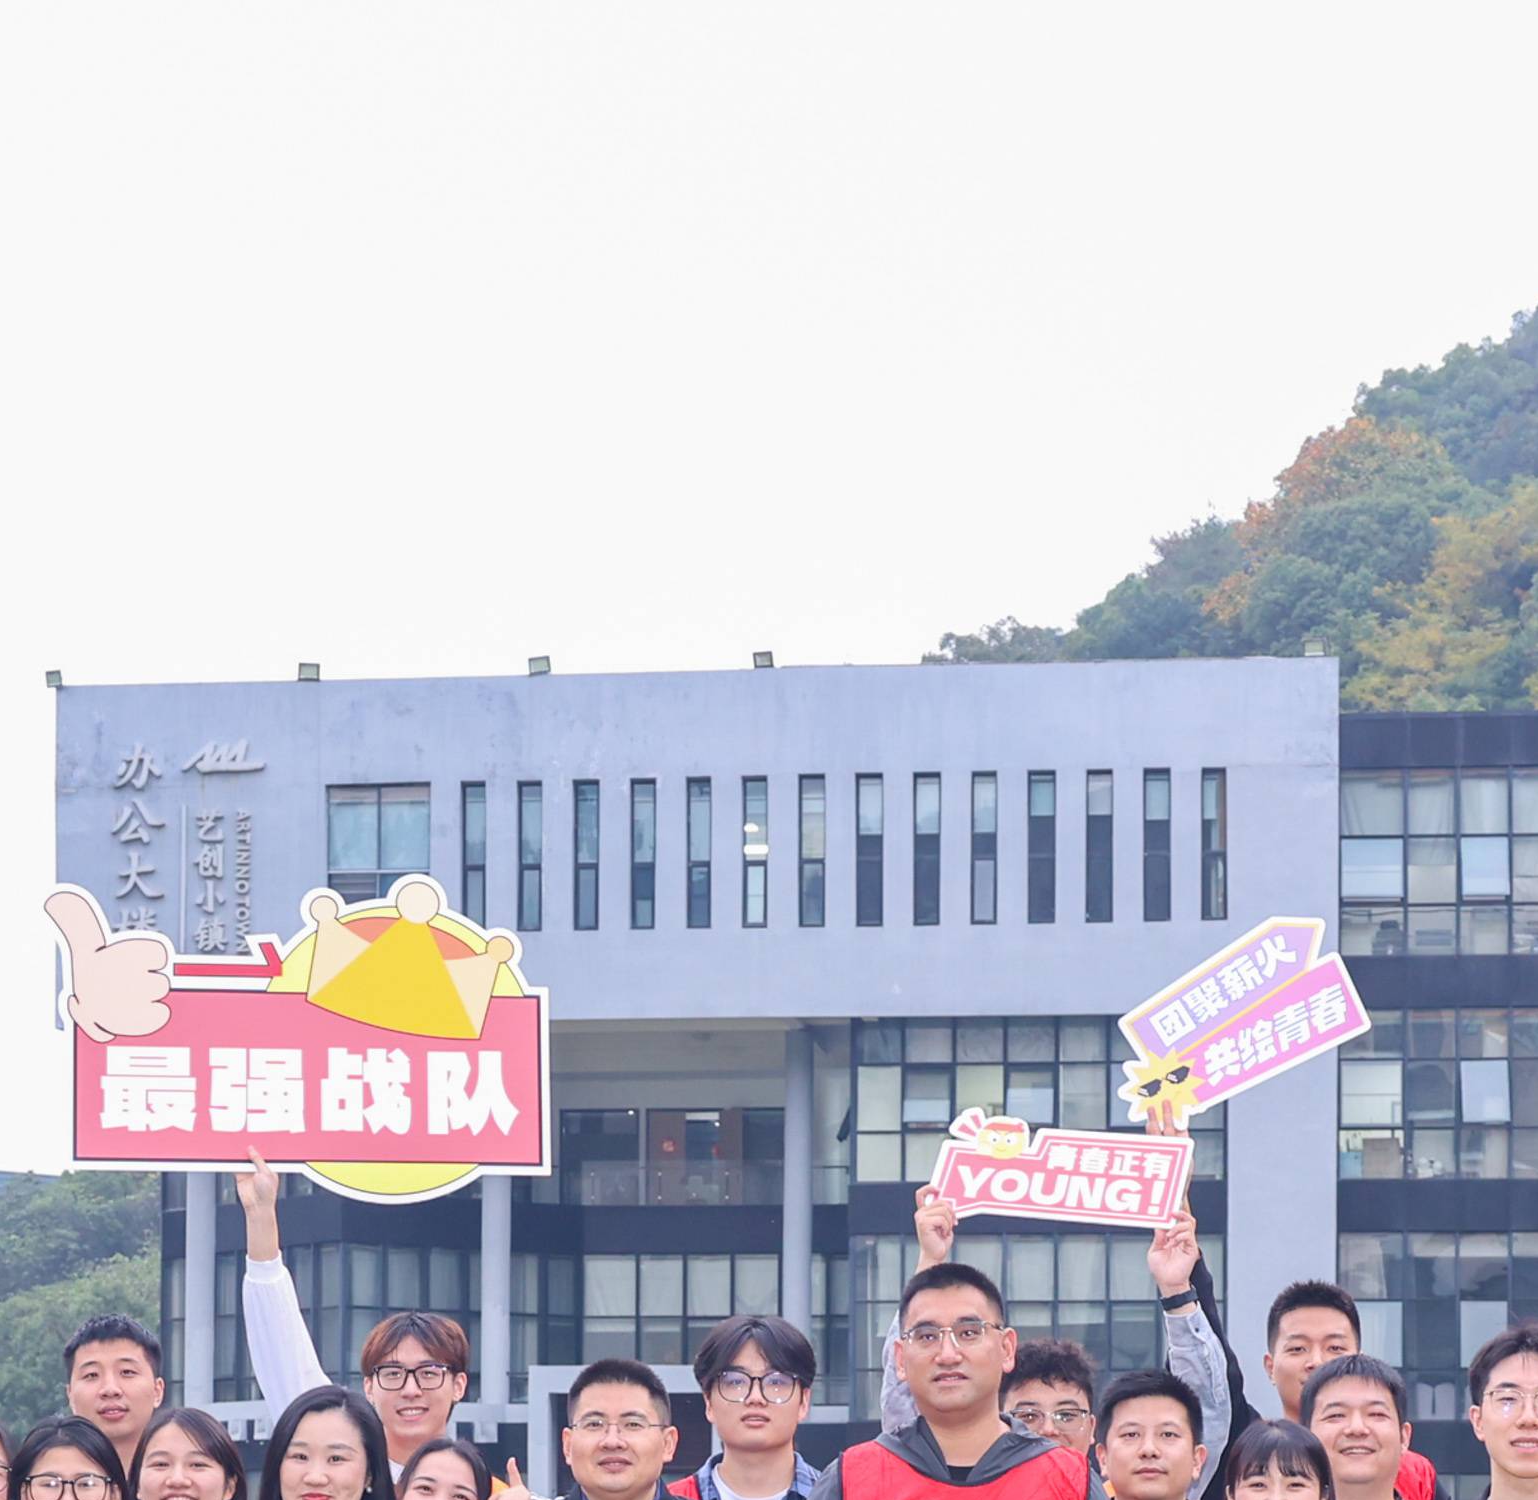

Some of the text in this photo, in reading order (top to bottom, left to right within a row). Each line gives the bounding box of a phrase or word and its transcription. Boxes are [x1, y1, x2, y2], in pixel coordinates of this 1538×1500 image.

[194, 810, 228, 951] 艺创小镇
[1150, 933, 1297, 1048] 团聚薪火
[1203, 983, 1349, 1086] 共绘青春
[100, 1046, 520, 1136] 最强战队
[958, 1164, 1167, 1216] YOUNG!
[1047, 1143, 1173, 1181] 青春正有
